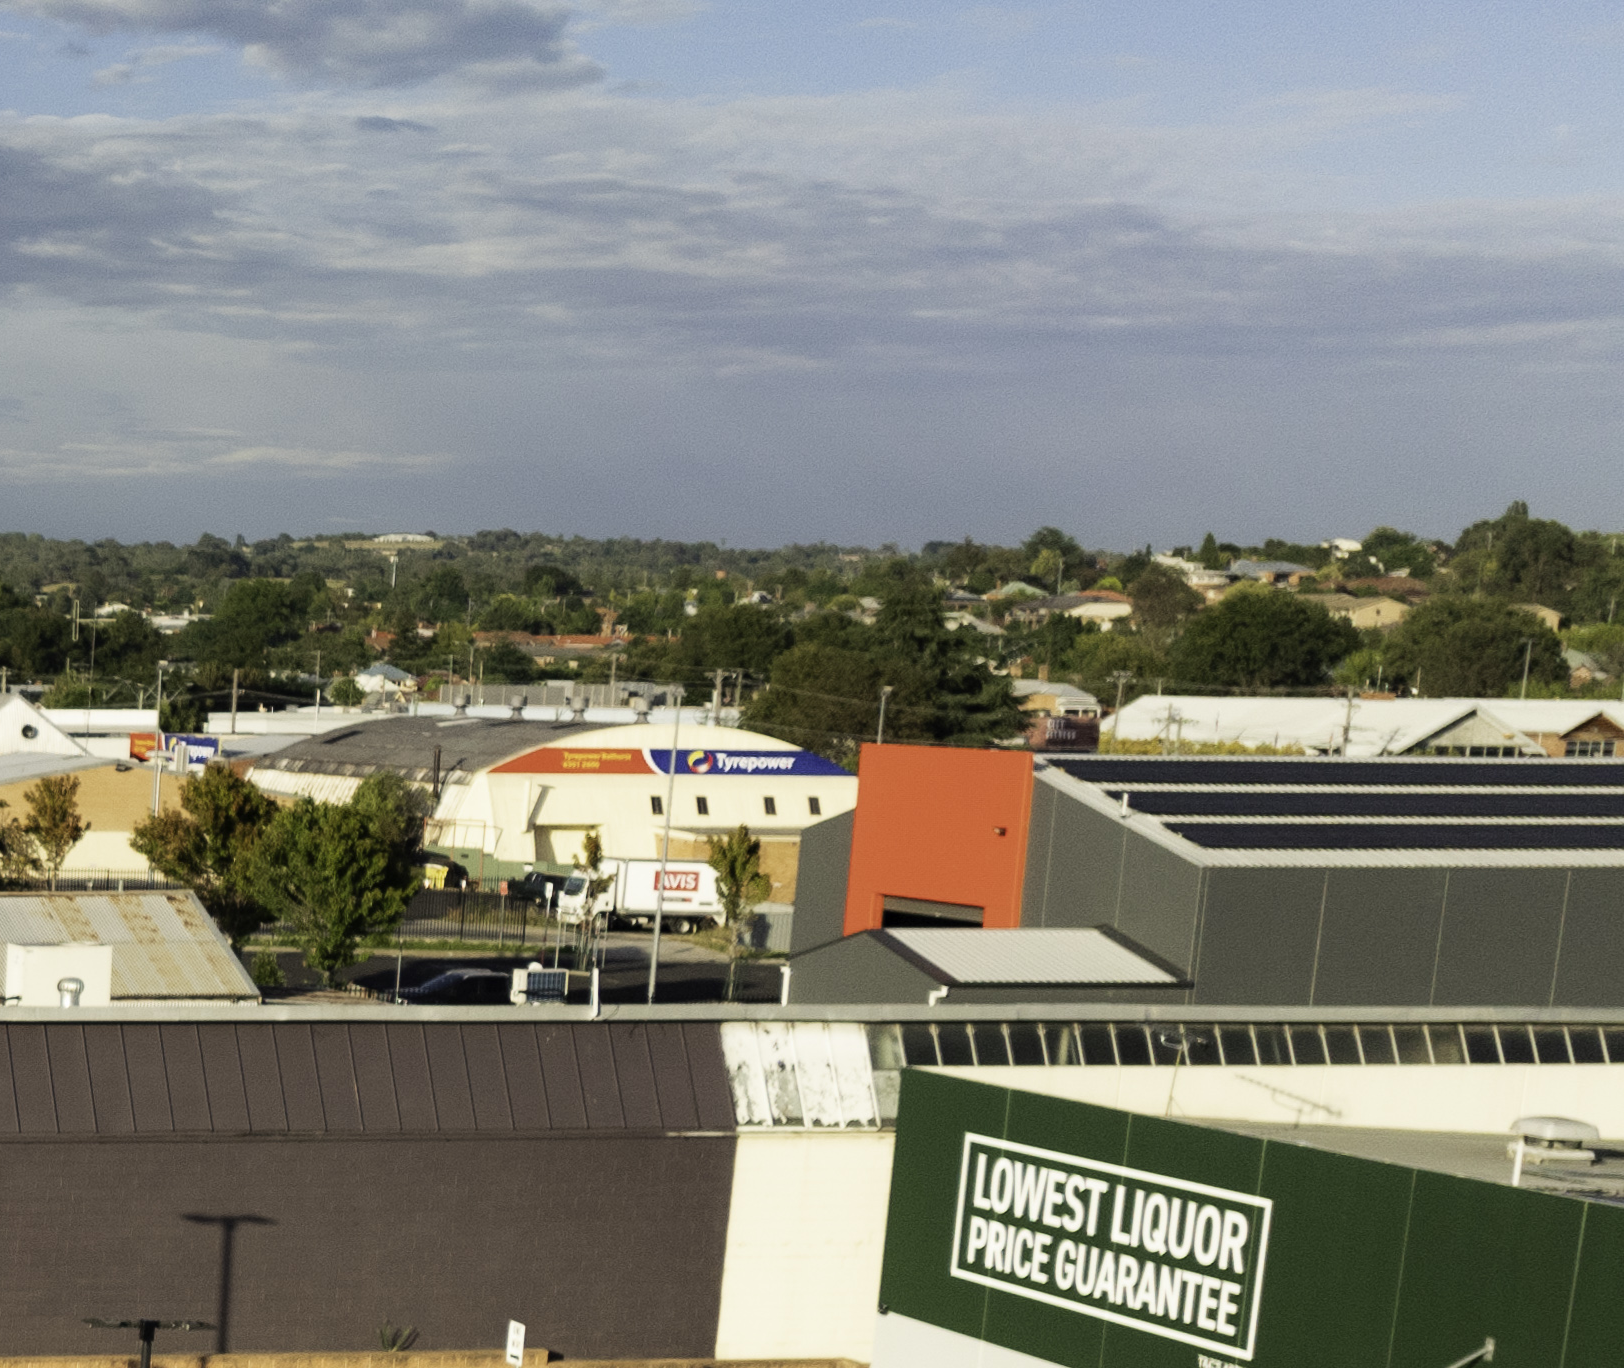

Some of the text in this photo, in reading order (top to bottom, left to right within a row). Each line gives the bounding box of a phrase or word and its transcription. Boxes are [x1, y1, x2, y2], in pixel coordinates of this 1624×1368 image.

[715, 753, 796, 772] Tyrepower
[657, 873, 697, 890] AVIS
[972, 1152, 1248, 1275] LOWEST LIQUOR
[966, 1216, 1243, 1337] PRICE GUARANTEE
